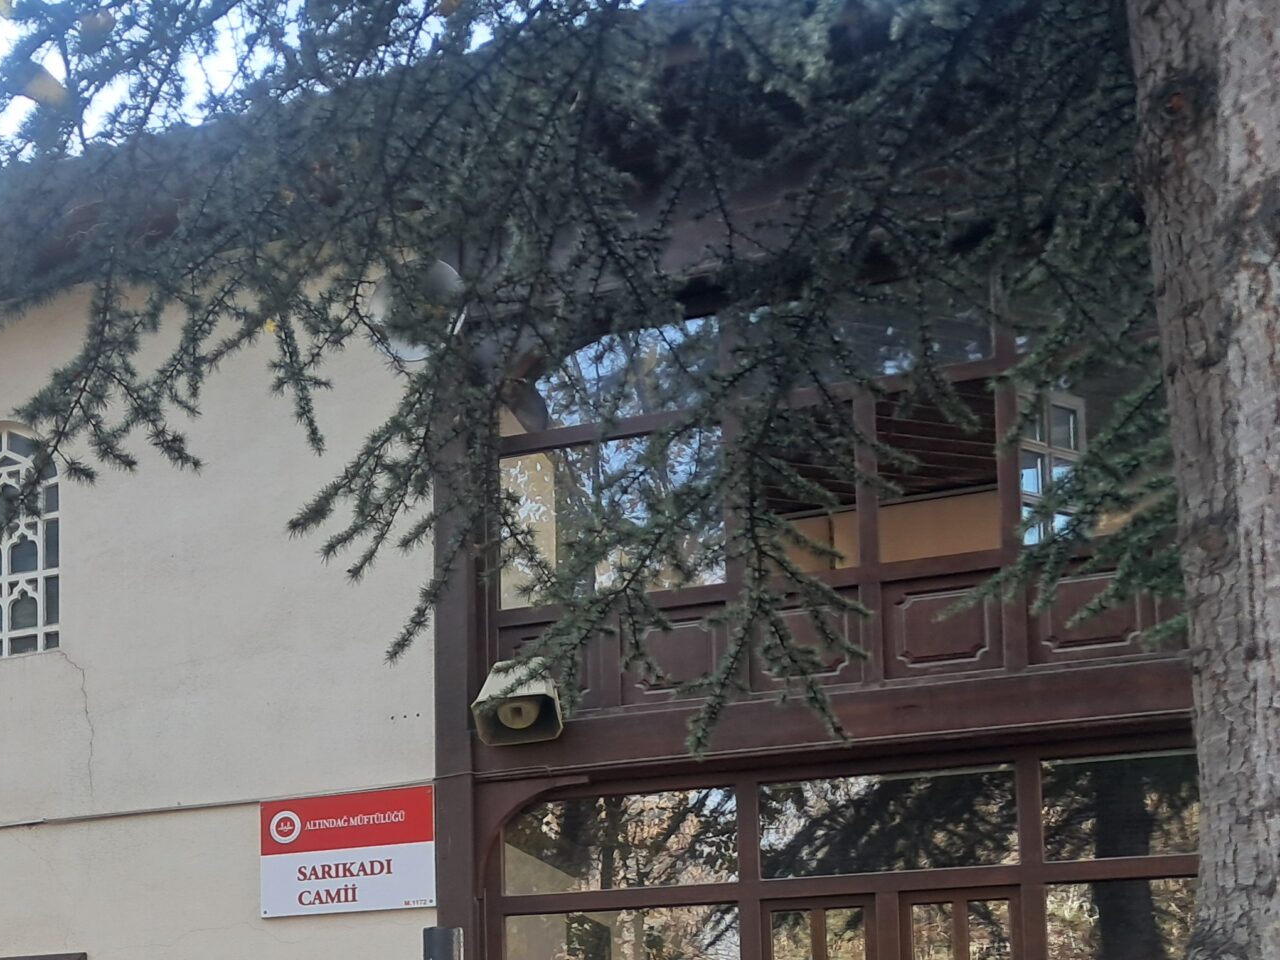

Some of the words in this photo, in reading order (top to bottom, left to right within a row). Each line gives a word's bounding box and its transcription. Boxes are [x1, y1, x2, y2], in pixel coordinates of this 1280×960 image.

[304, 815, 348, 831] ALTINDAĞ
[349, 809, 405, 826] MÜFTÜLÜĞÜ
[297, 858, 393, 882] SARIKADI
[297, 883, 358, 906] CAMİİ
